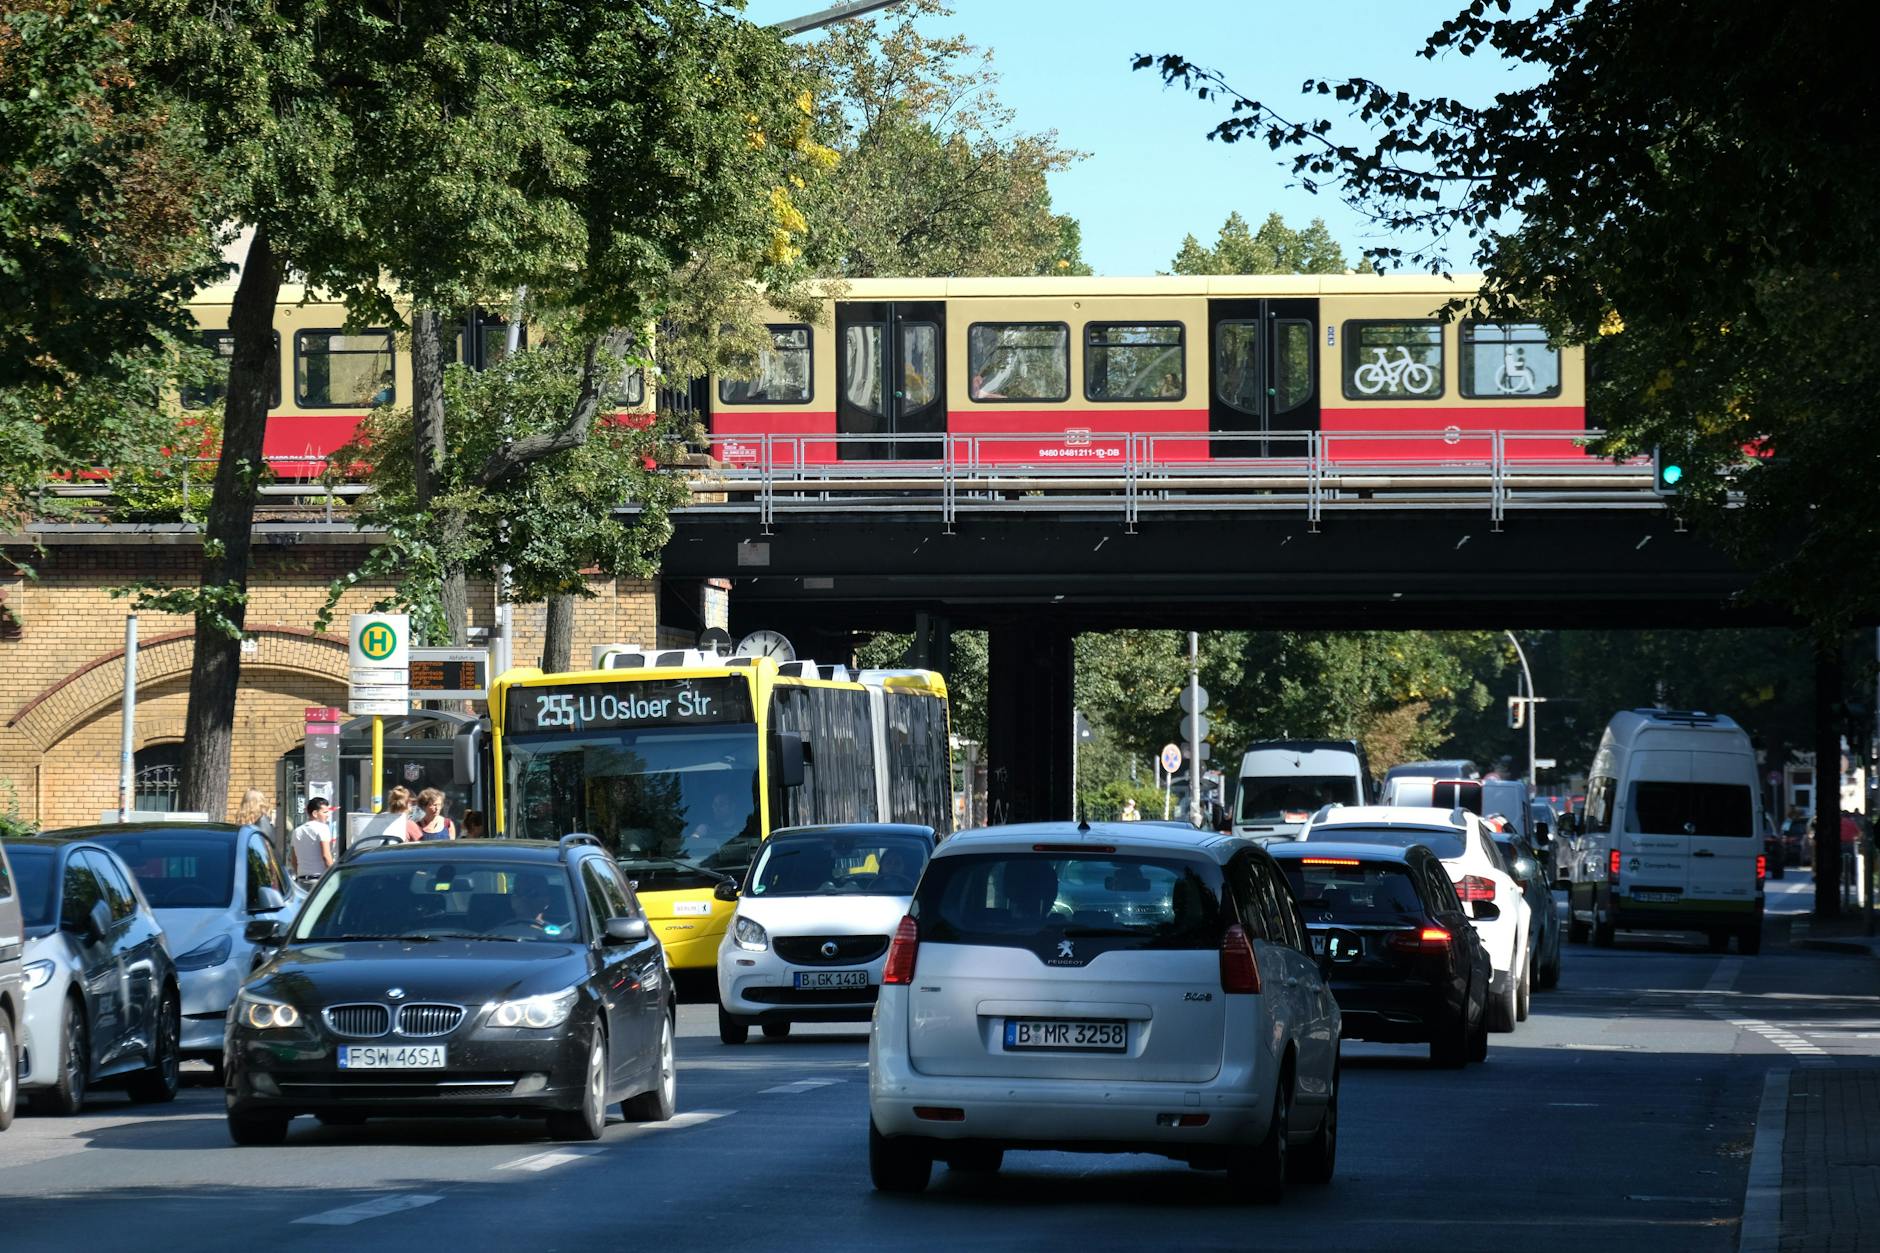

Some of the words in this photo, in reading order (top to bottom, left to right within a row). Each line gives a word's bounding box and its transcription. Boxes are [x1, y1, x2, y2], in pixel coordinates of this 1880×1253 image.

[369, 631, 387, 652] H
[536, 694, 575, 727] 255
[579, 695, 596, 722] U
[600, 693, 672, 721] Osloer
[677, 690, 717, 717] Str.
[802, 973, 810, 986] B
[818, 973, 833, 986] GK
[836, 972, 866, 986] 1418
[1018, 1023, 1031, 1043] B
[1045, 1024, 1069, 1044] MR
[1075, 1024, 1123, 1045] 3258
[350, 1048, 389, 1066] FSW
[396, 1047, 442, 1066] 46SA
